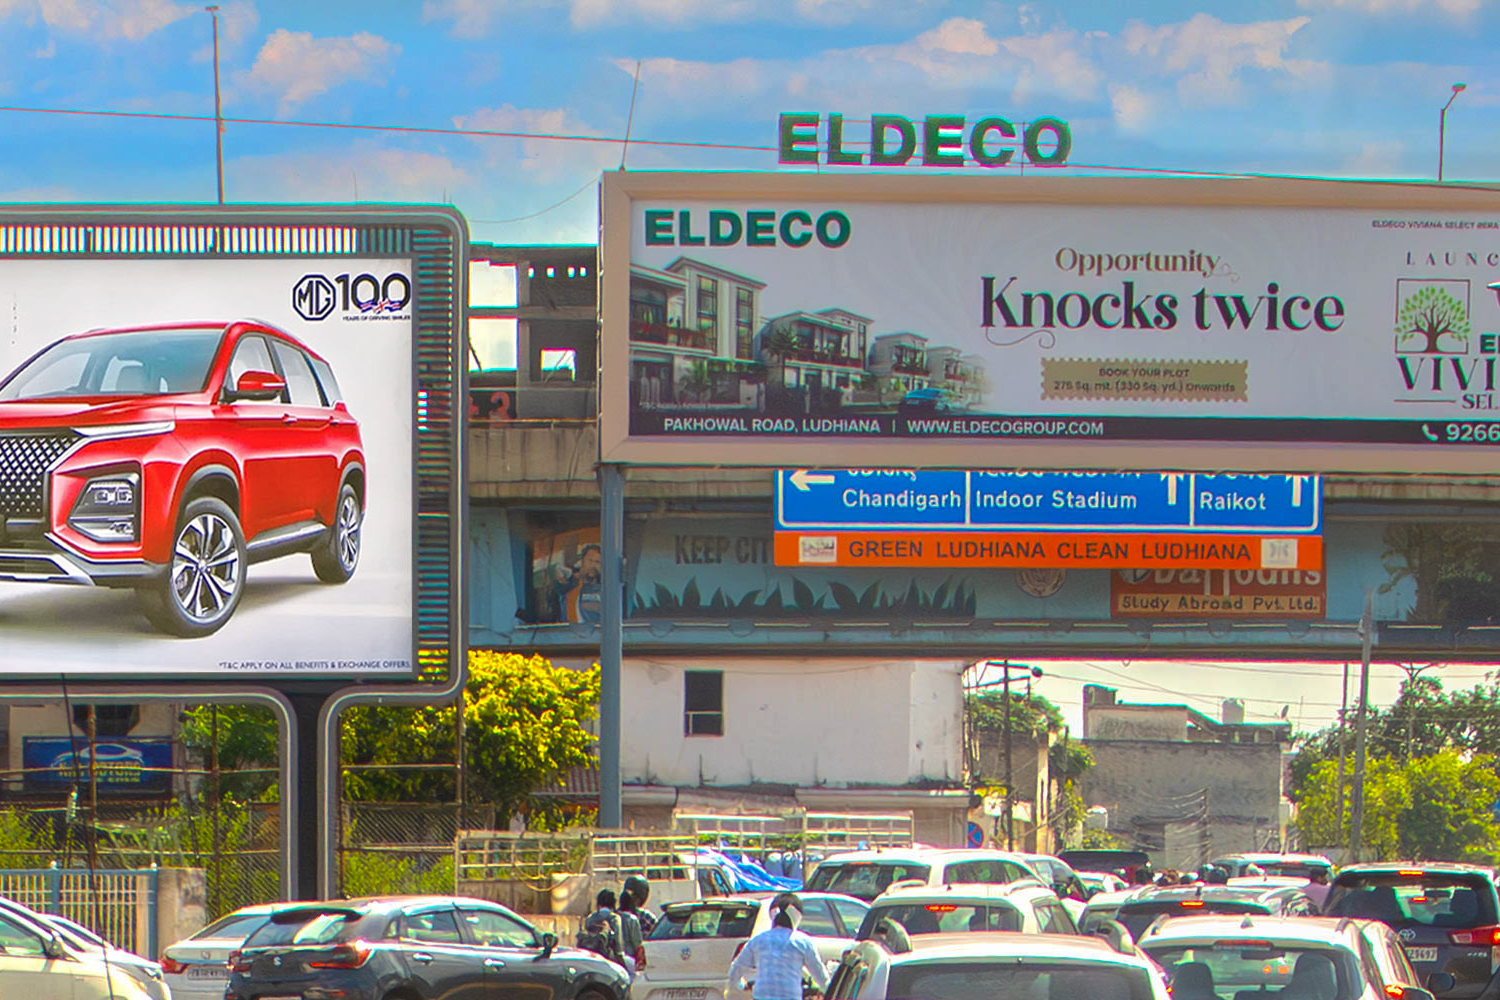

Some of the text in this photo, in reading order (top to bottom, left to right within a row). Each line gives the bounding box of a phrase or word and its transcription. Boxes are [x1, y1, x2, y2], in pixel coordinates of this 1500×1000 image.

[778, 112, 1072, 167] ELDECO
[644, 209, 851, 249] ELDECO
[1055, 247, 1222, 277] Opportunity
[293, 273, 411, 320] MG 100
[980, 276, 1345, 331] Knocks twice
[1480, 333, 1500, 354] E
[1099, 368, 1190, 378] BOOK YOUR PLOT
[664, 418, 1104, 435] PAKHOWAL ROAD, LUDHIANA WWW.ELDECOGROUP.COM
[842, 489, 961, 511] Chandigarh
[976, 491, 1138, 509] Indoor Stadium
[1199, 492, 1267, 511] Raikot
[674, 535, 731, 565] KEEP
[849, 540, 923, 558] GREEN
[937, 541, 1046, 559] LUDHIANA
[1057, 542, 1130, 559] CLEAN
[1141, 543, 1252, 561] LUDHIANA
[1121, 595, 1169, 611] Study
[1178, 596, 1244, 611] Abroad
